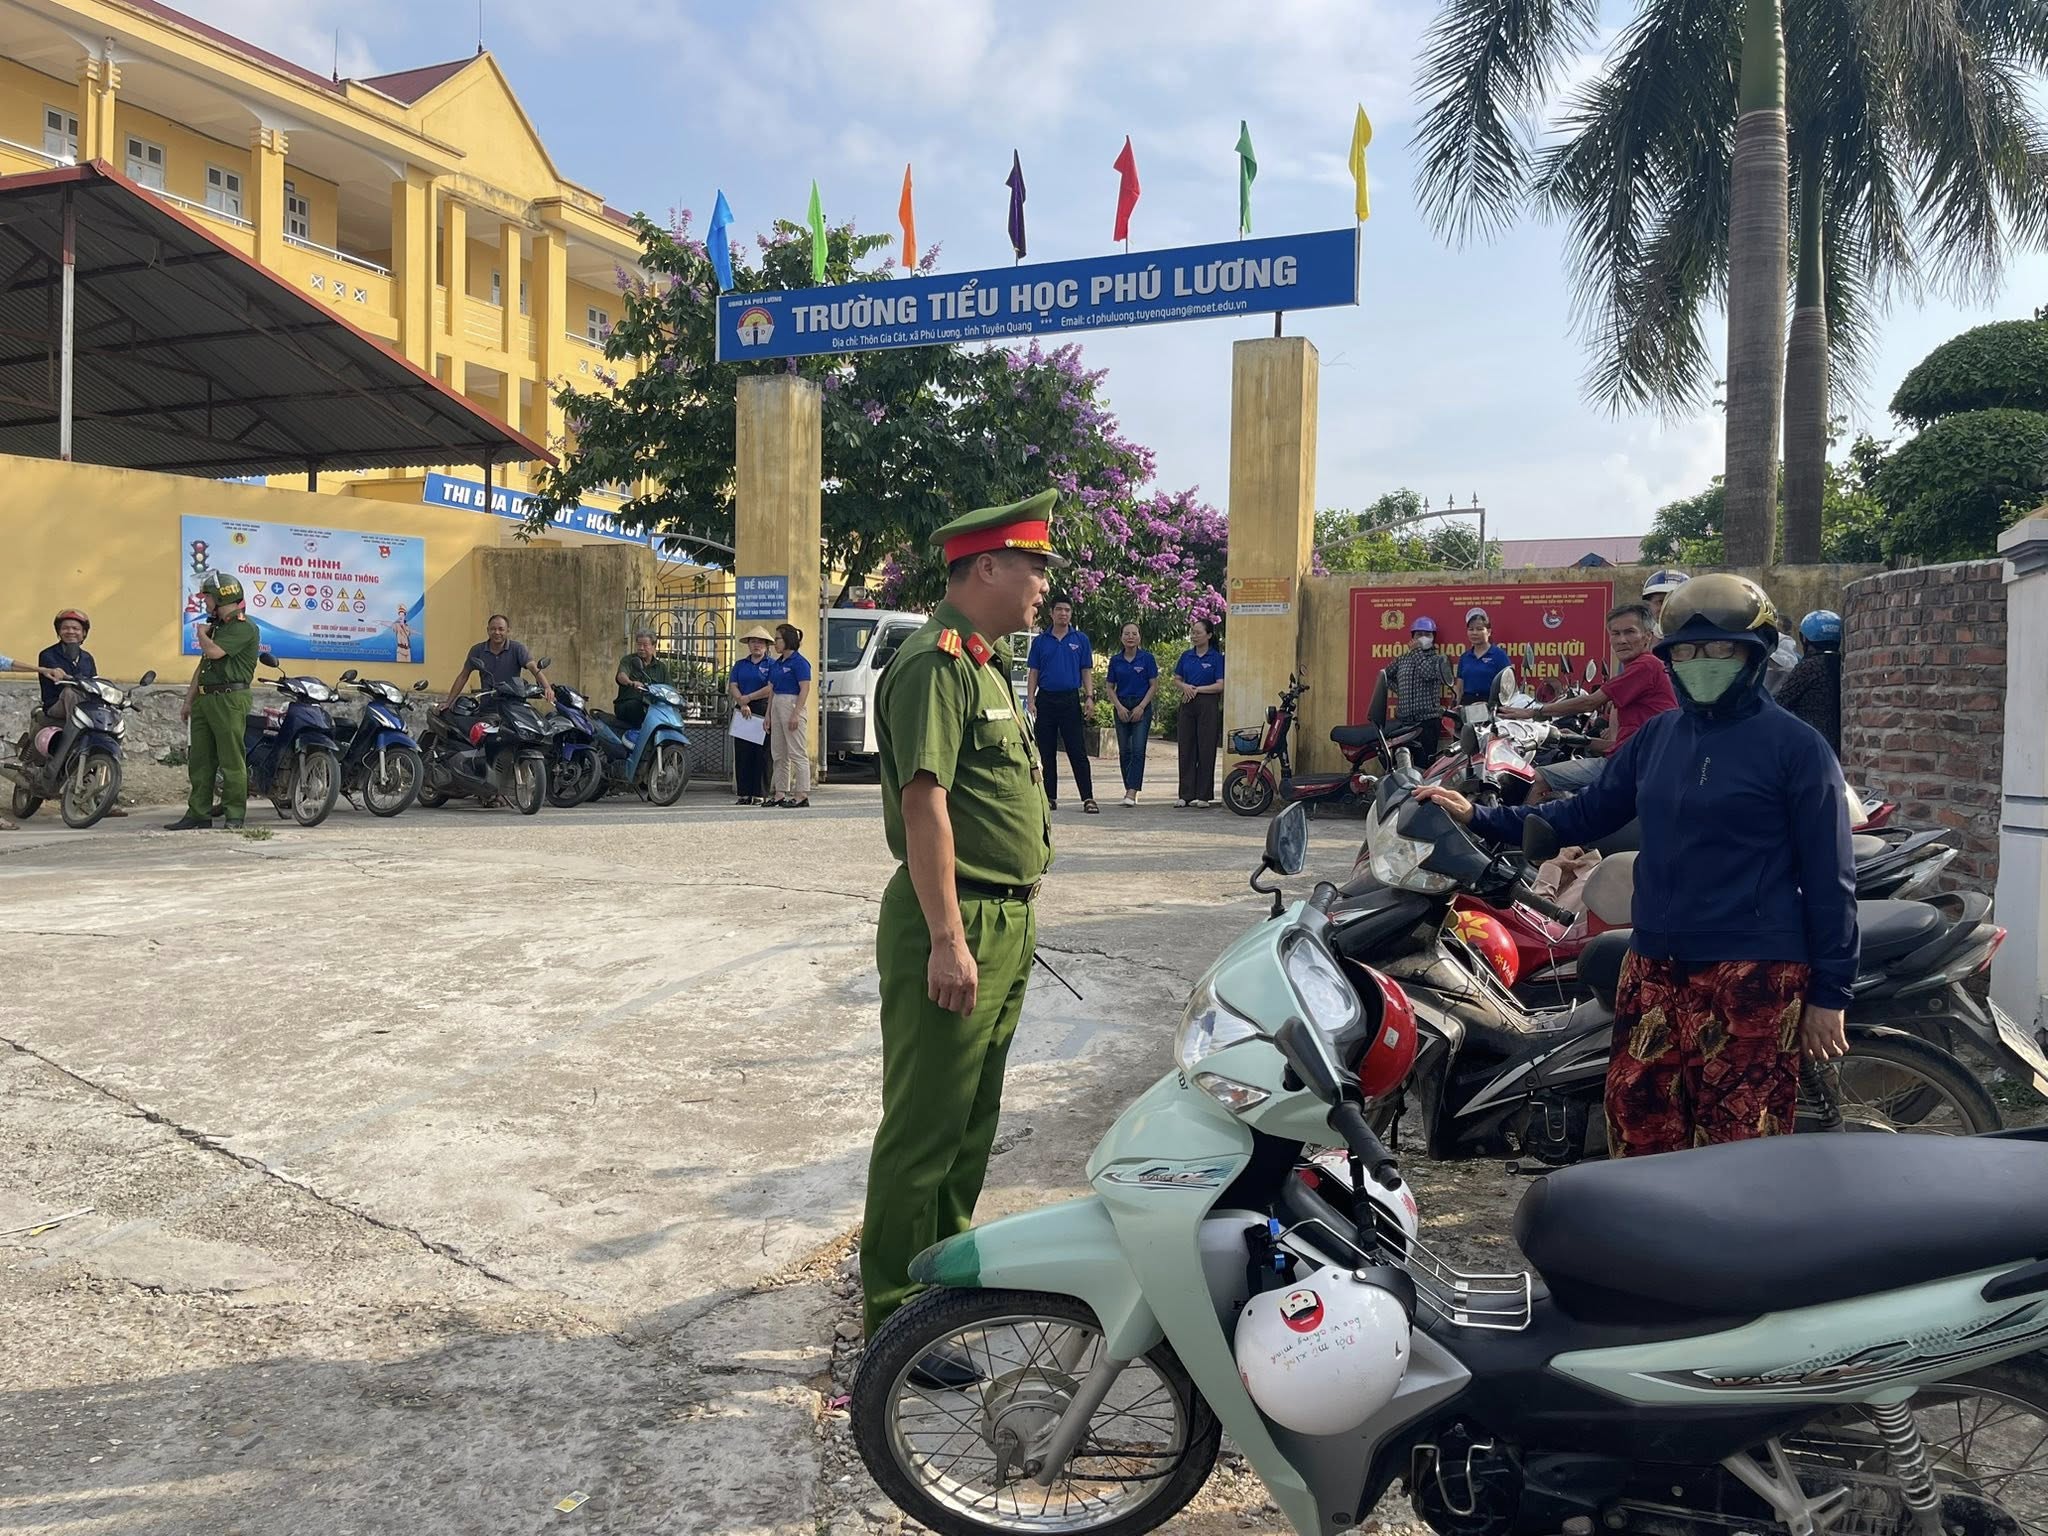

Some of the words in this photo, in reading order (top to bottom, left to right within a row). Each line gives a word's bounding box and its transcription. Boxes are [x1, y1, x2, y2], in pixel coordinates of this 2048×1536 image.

[792, 294, 918, 334] TRƯỜNG
[927, 278, 999, 321] TIỂU
[1010, 279, 1078, 316] HỌC
[1090, 263, 1162, 306] PHÚ
[1174, 255, 1297, 297] LƯƠNG
[1061, 316, 1085, 327] Email:
[1086, 300, 1247, 326] c1phuluong.tuyenquang@moet.edu.vn
[860, 335, 879, 345] Thôn
[880, 333, 892, 343] Gia
[909, 330, 919, 340] xã
[920, 329, 936, 340] Phú
[964, 325, 980, 336] tỉnh
[981, 323, 1005, 336] Tuyên
[1006, 322, 1032, 333] Quang
[443, 483, 471, 505] THI
[280, 555, 303, 567] MÔ
[308, 557, 341, 570] HÌNH
[298, 569, 310, 579] AN
[312, 569, 333, 580] TOÀN
[334, 572, 353, 582] GIAO
[354, 574, 379, 584] THÔNG
[757, 580, 779, 591] NGHỊ
[1535, 639, 1585, 656] NGƯỜI
